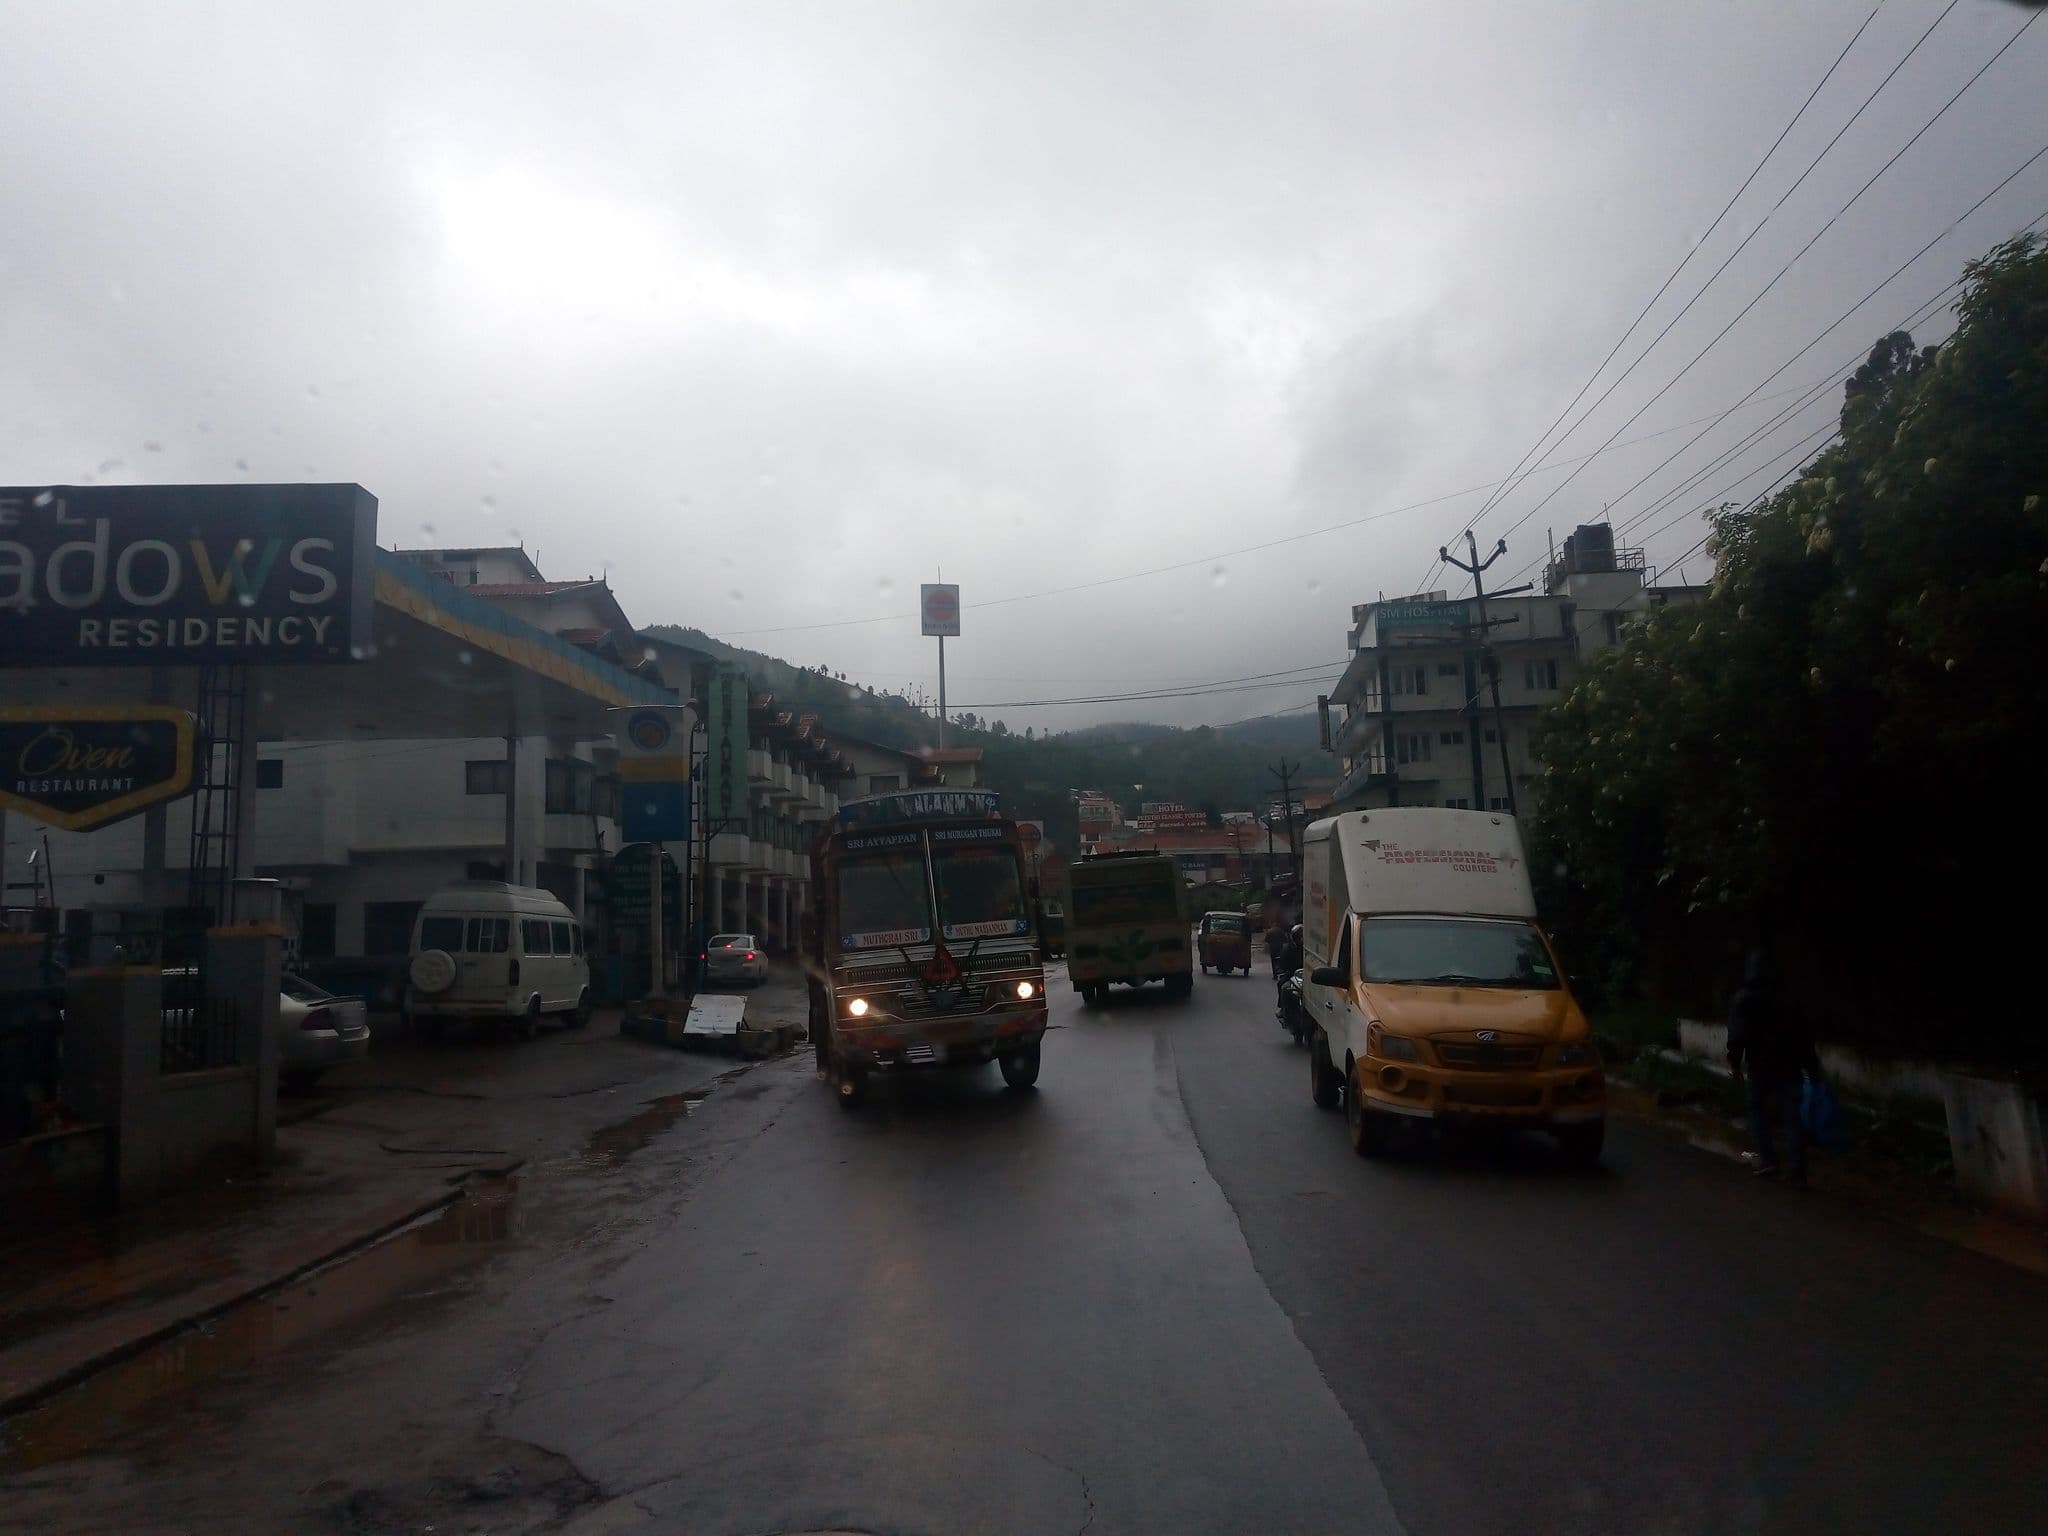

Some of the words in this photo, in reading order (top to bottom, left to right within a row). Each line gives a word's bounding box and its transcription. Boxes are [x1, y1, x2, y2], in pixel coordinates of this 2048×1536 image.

[79, 615, 332, 648] RESIDENCY
[17, 727, 136, 776] Oven
[16, 776, 136, 794] RESTAURANT
[1158, 804, 1185, 812] HOTEL
[847, 838, 864, 849] SRI
[867, 833, 917, 847] AYYAPPAN
[1382, 842, 1398, 850] THE
[1453, 864, 1498, 873] COURIERS
[904, 930, 919, 942] SRI
